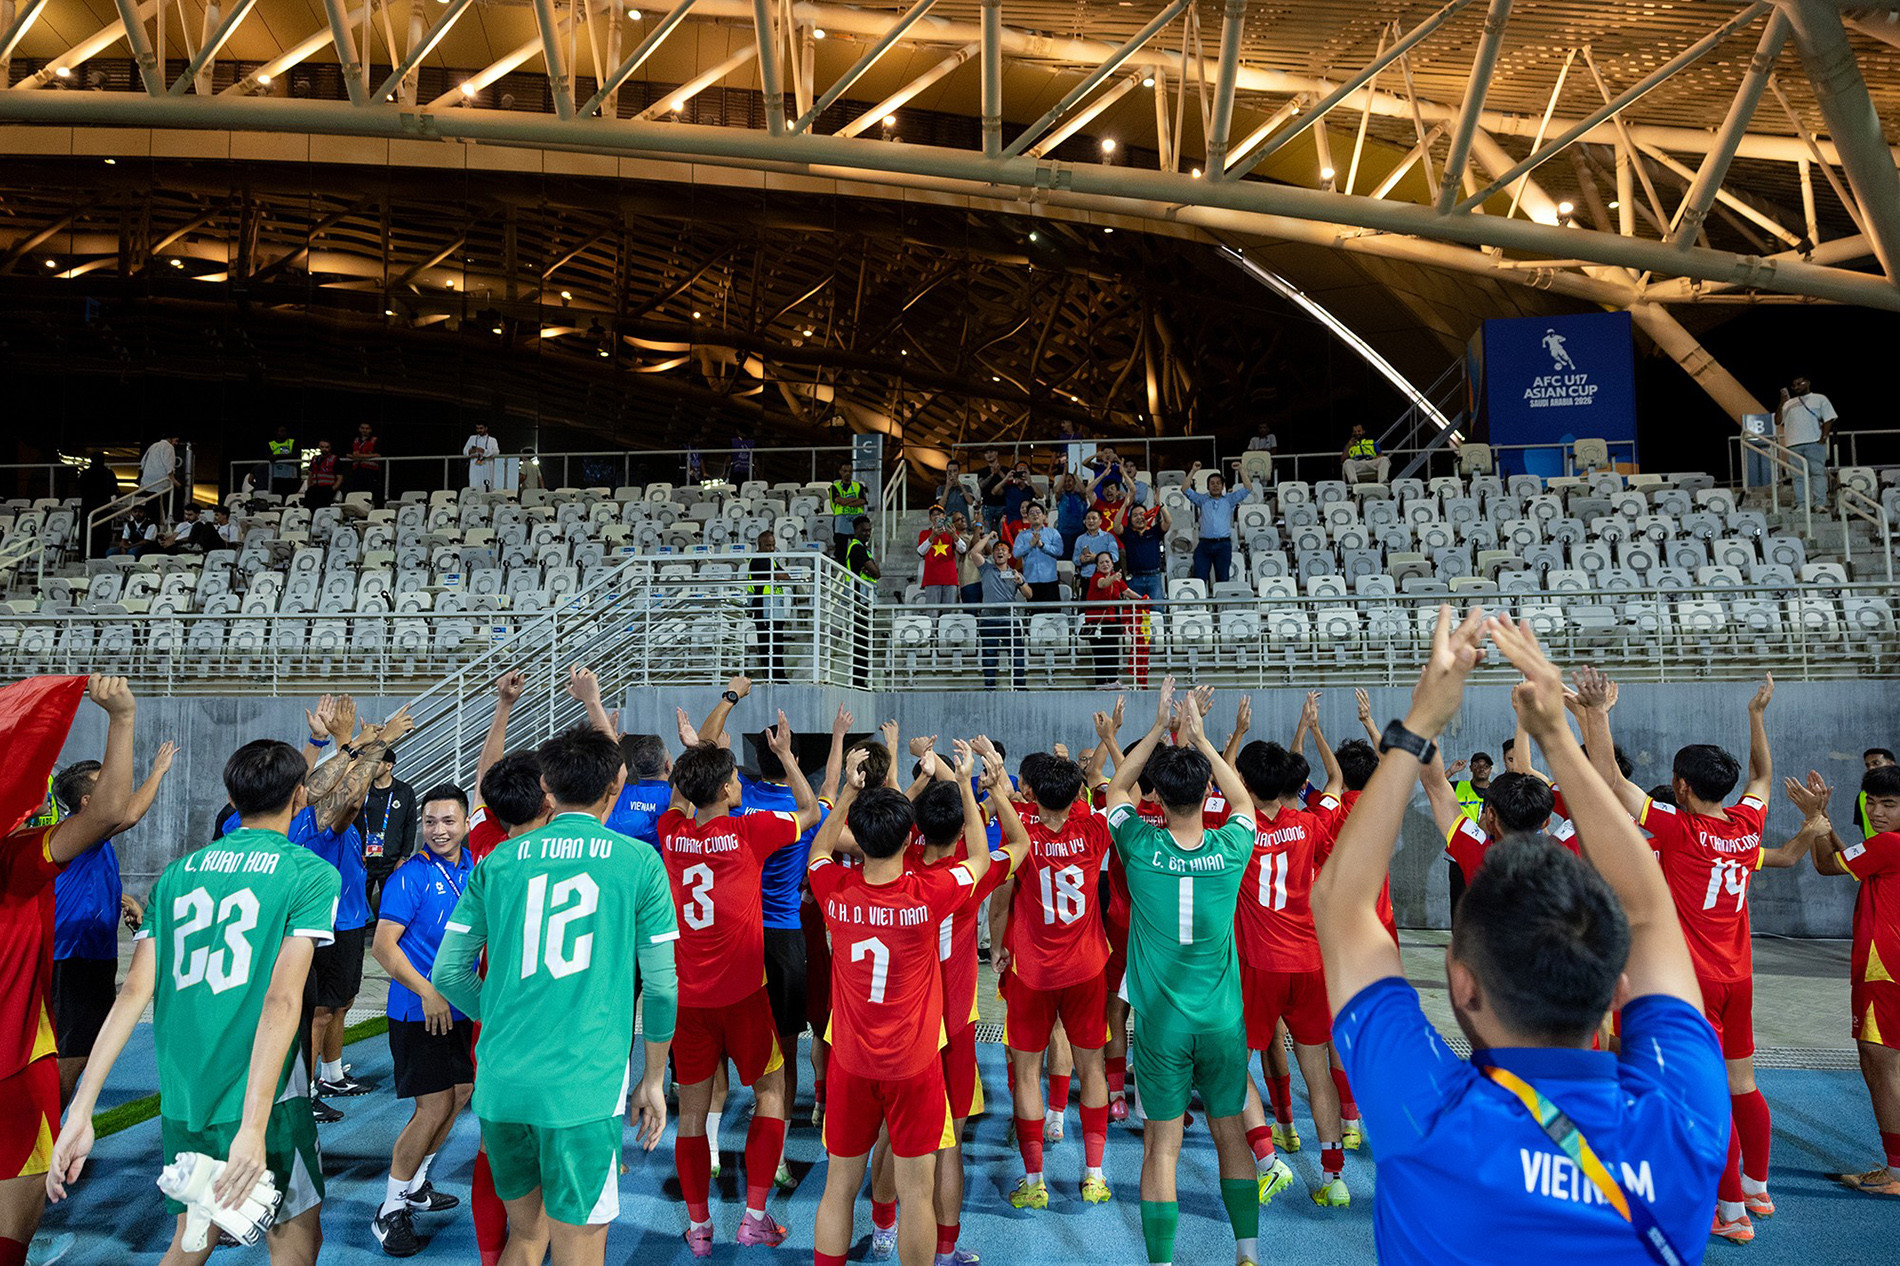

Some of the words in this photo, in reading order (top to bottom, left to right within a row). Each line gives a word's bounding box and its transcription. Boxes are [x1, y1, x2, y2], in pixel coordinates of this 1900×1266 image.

[1523, 387, 1566, 399] ASIAN
[1568, 385, 1598, 396] CUP
[1533, 376, 1561, 387] AFC
[1564, 374, 1588, 385] U17
[1530, 399, 1549, 408] SAUDI
[1550, 398, 1574, 407] ARABIA
[1574, 396, 1592, 405] 2026
[1754, 420, 1765, 434] B
[704, 834, 738, 854] CUONG
[1033, 840, 1042, 856] T.
[1045, 842, 1068, 857] DINH
[1070, 838, 1085, 854] VY
[1272, 825, 1306, 846] DUONG
[517, 840, 532, 860] N.
[540, 837, 584, 860] TUAN
[589, 837, 613, 859] VU
[1152, 851, 1164, 868] C.
[242, 850, 280, 874] HOA
[1258, 851, 1288, 912] 11
[1702, 857, 1749, 913] 14
[682, 862, 714, 931] 3
[1039, 864, 1086, 926] 18
[828, 900, 836, 920] N.
[838, 903, 850, 923] H.
[854, 906, 865, 925] D.
[869, 906, 895, 926] VIET
[899, 905, 928, 926] NAM
[1179, 876, 1193, 946] 1
[521, 872, 600, 980] 12
[172, 886, 260, 996] 23
[850, 936, 890, 1004] 7
[1520, 1148, 1656, 1205] VIETNM
